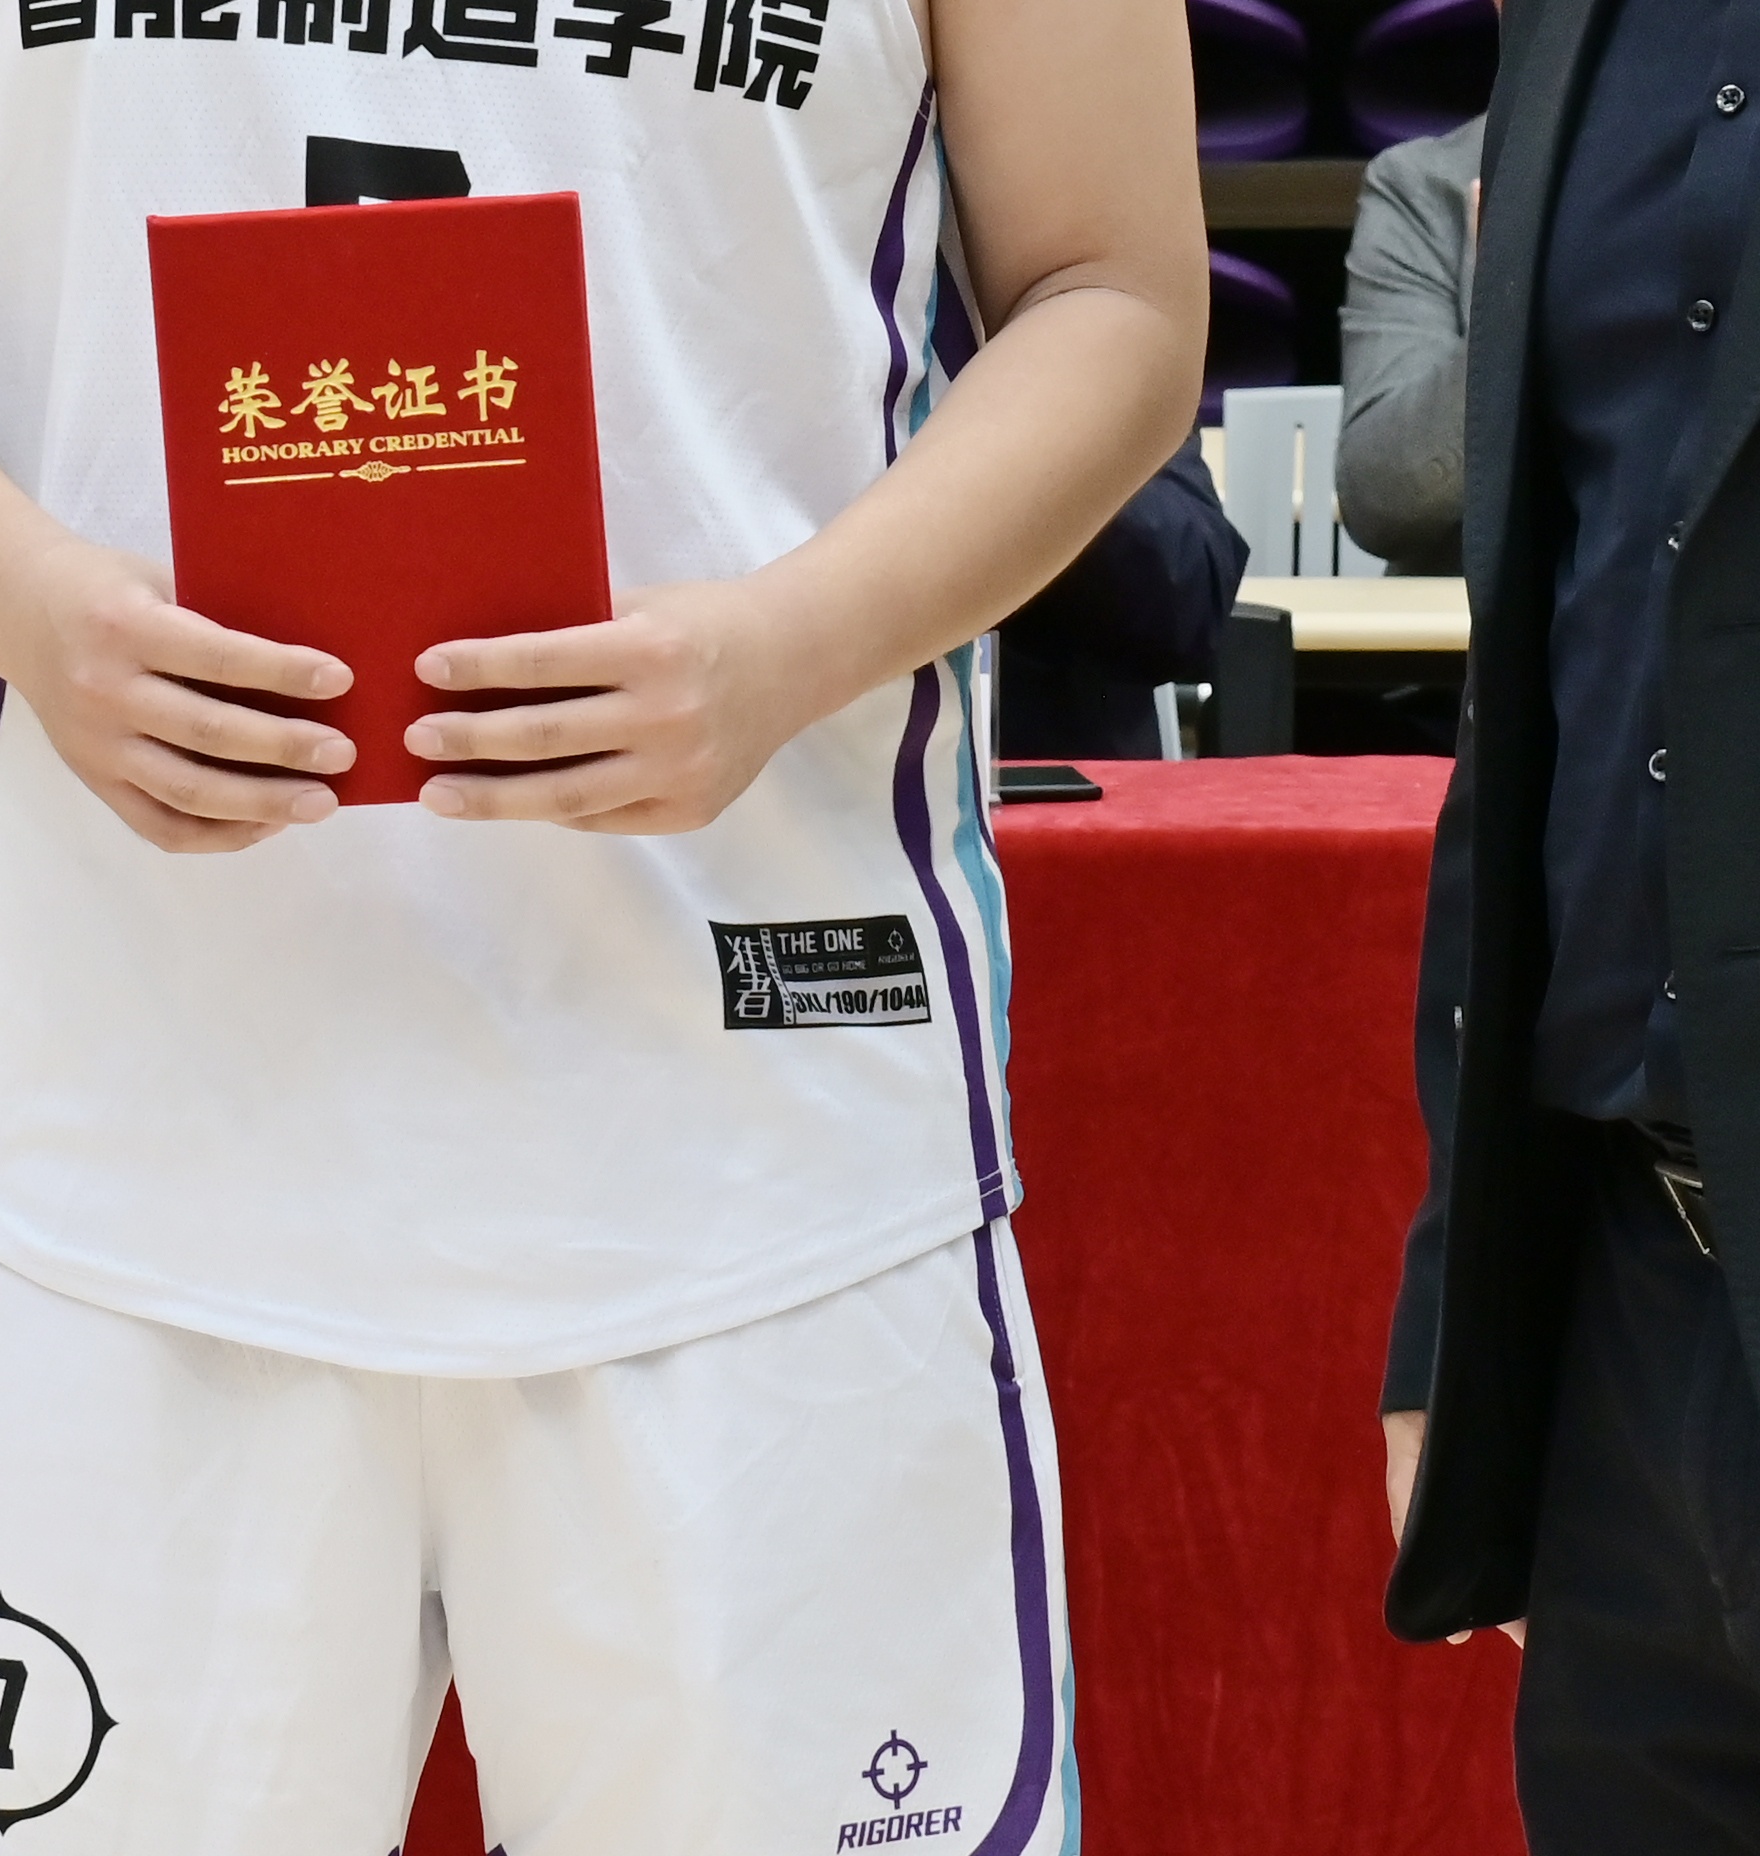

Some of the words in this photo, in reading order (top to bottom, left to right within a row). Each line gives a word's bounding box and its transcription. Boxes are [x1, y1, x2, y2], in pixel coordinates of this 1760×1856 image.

[218, 349, 519, 439] 荣誉证书
[221, 438, 365, 464] HONORARY
[369, 427, 525, 454] CREDENTIAL
[776, 931, 818, 955] THE
[823, 928, 864, 952] ONE
[837, 1805, 962, 1855] RIGORER
